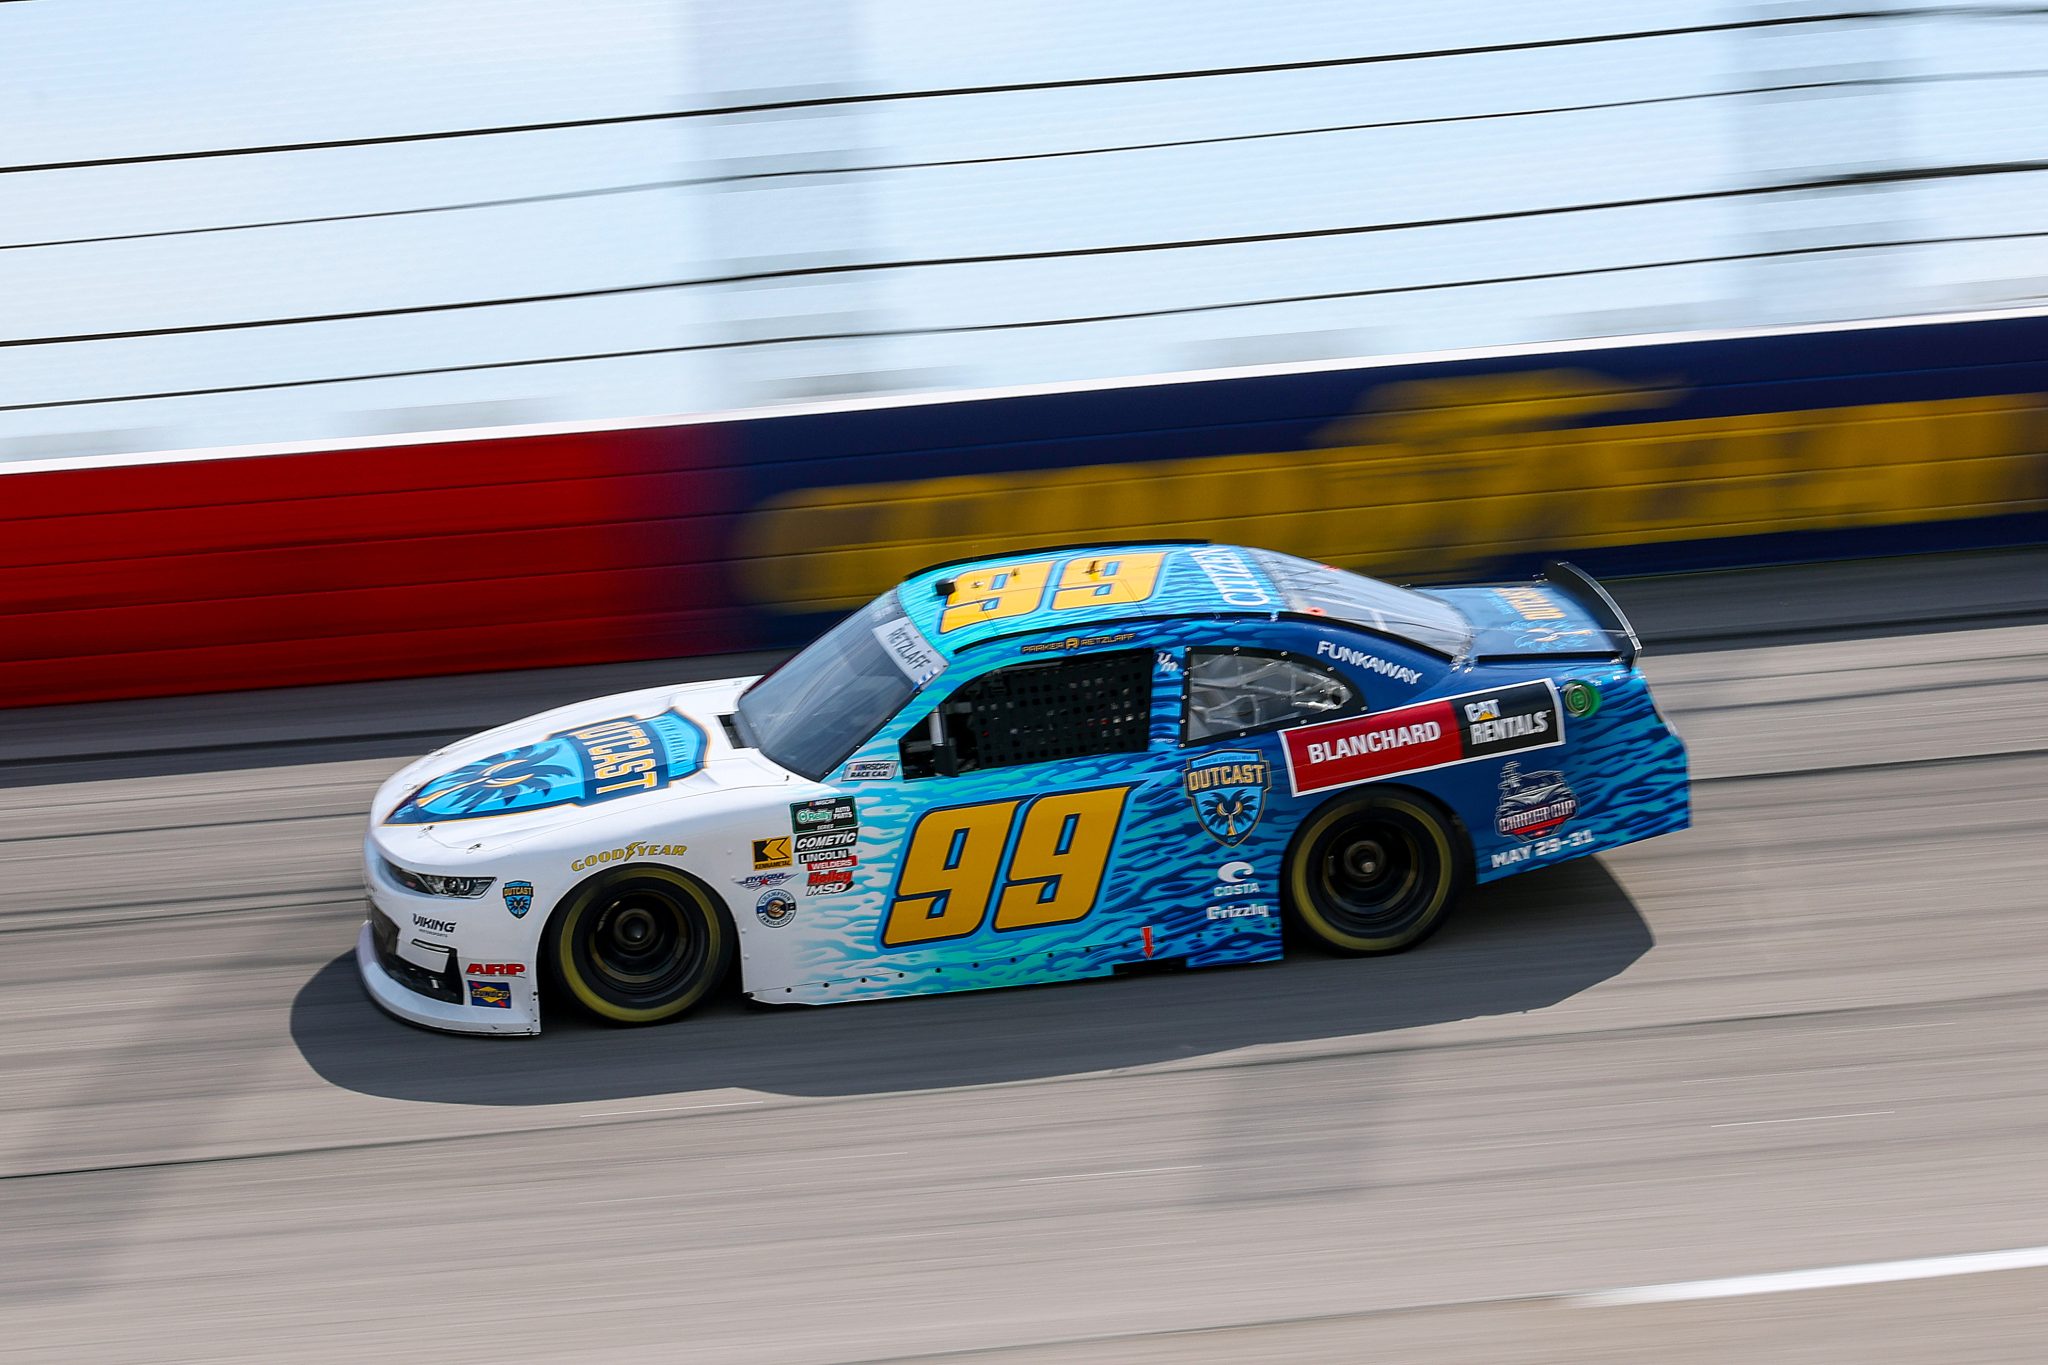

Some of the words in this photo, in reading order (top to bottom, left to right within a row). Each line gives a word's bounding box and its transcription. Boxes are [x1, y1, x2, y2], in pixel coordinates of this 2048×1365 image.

[939, 552, 1169, 634] 99
[1021, 642, 1065, 654] PARKER
[1080, 632, 1136, 647] RETZLAFF
[1317, 640, 1423, 685] FUNKAWAY
[1464, 699, 1501, 723] CAT
[1469, 709, 1551, 746] RENTALS
[1307, 721, 1442, 764] BLANCHARD
[566, 721, 657, 794] OUTCAST
[1187, 764, 1265, 791] OUTCAST
[796, 832, 857, 849] COMETIC
[570, 840, 688, 872] GOODYEAR
[800, 850, 848, 863] LINCOLN
[811, 859, 853, 870] WELDERS
[881, 785, 1132, 949] 99
[1490, 844, 1533, 869] MAY
[503, 886, 532, 897] OUTCAST
[806, 881, 849, 897] MSD
[1213, 882, 1260, 897] COSTA
[413, 913, 457, 933] VIKING
[1206, 903, 1270, 920] Grizzly
[466, 963, 526, 976] ARP
